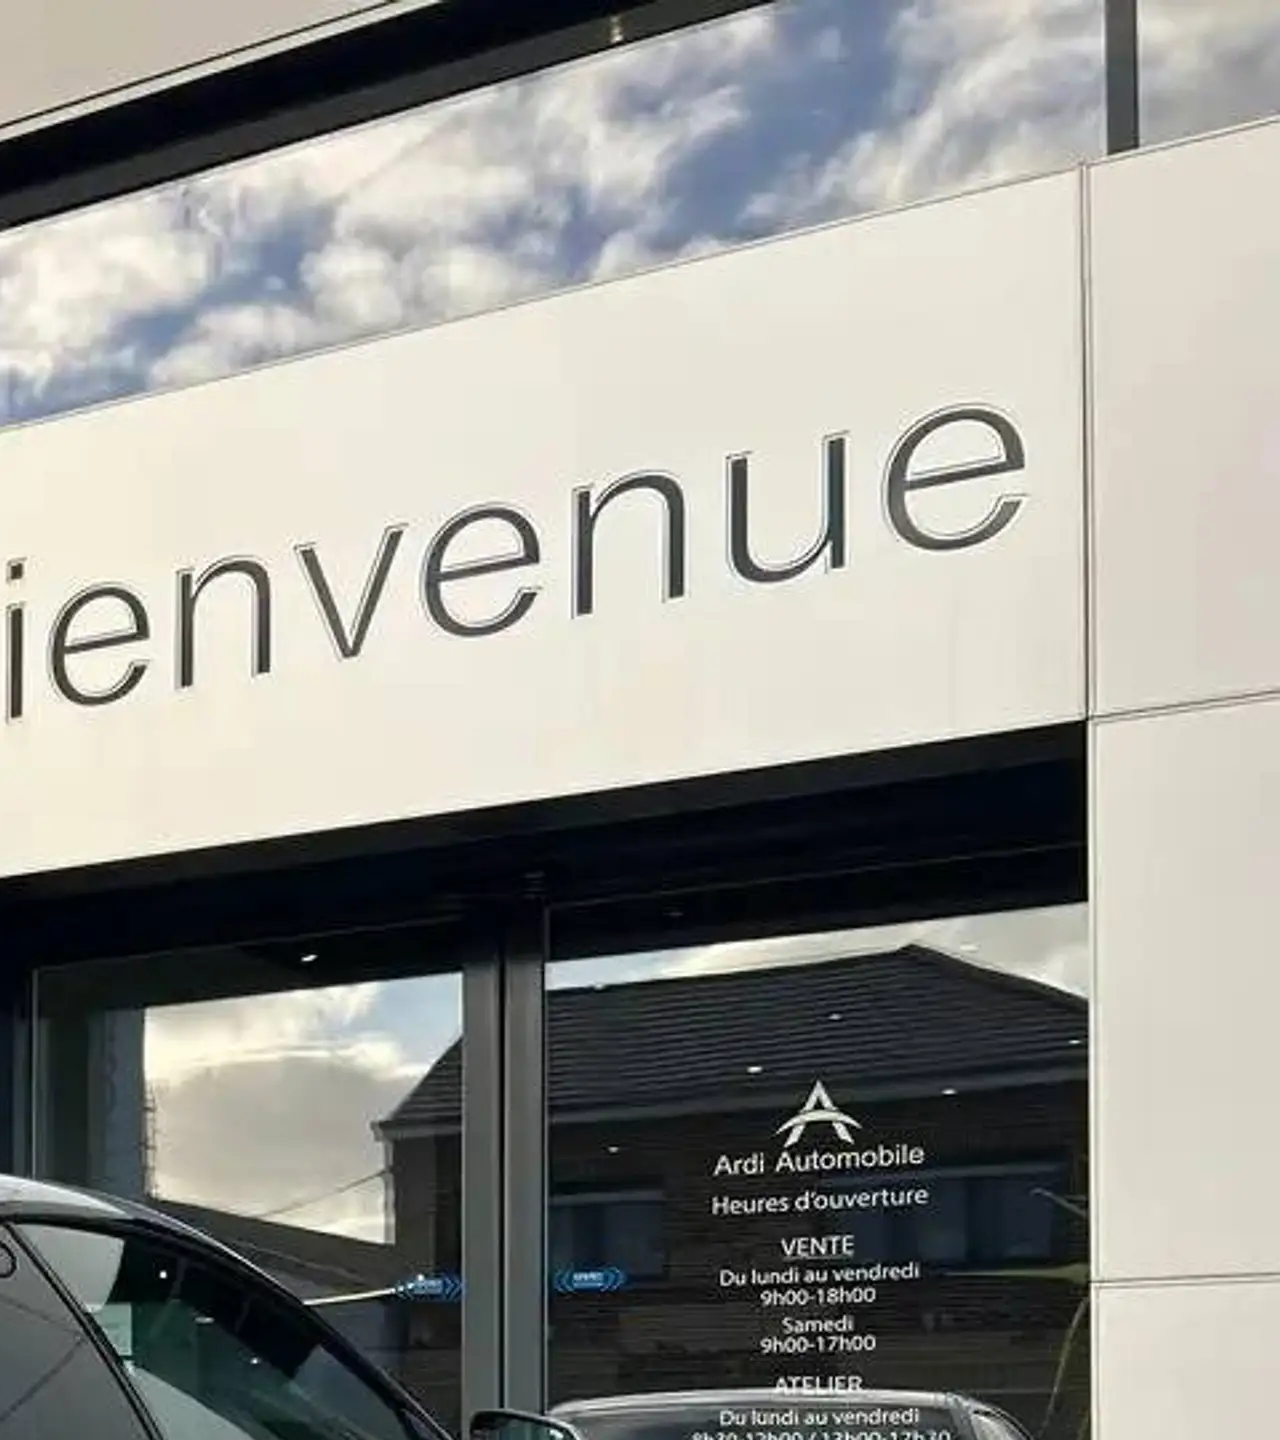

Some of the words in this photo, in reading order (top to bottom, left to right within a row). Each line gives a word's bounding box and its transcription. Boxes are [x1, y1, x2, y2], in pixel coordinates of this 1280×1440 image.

[711, 1152, 765, 1176] Ardi
[775, 1144, 925, 1173] Automobile
[711, 1195, 789, 1215] Heures
[794, 1187, 930, 1212] d'ouverture
[781, 1235, 855, 1257] VENTE
[719, 1269, 746, 1286] Du
[751, 1267, 800, 1285] lundi
[803, 1269, 828, 1284] au
[831, 1261, 920, 1283] vendredi
[759, 1287, 877, 1306] 9h00-18h00
[781, 1315, 855, 1334] Samedi
[759, 1335, 877, 1354] 9h00-17h00
[774, 1375, 864, 1395] ATELIER
[719, 1410, 746, 1426] Du
[751, 1408, 800, 1426] lundi
[803, 1411, 828, 1425] au
[831, 1407, 920, 1426] vendredi
